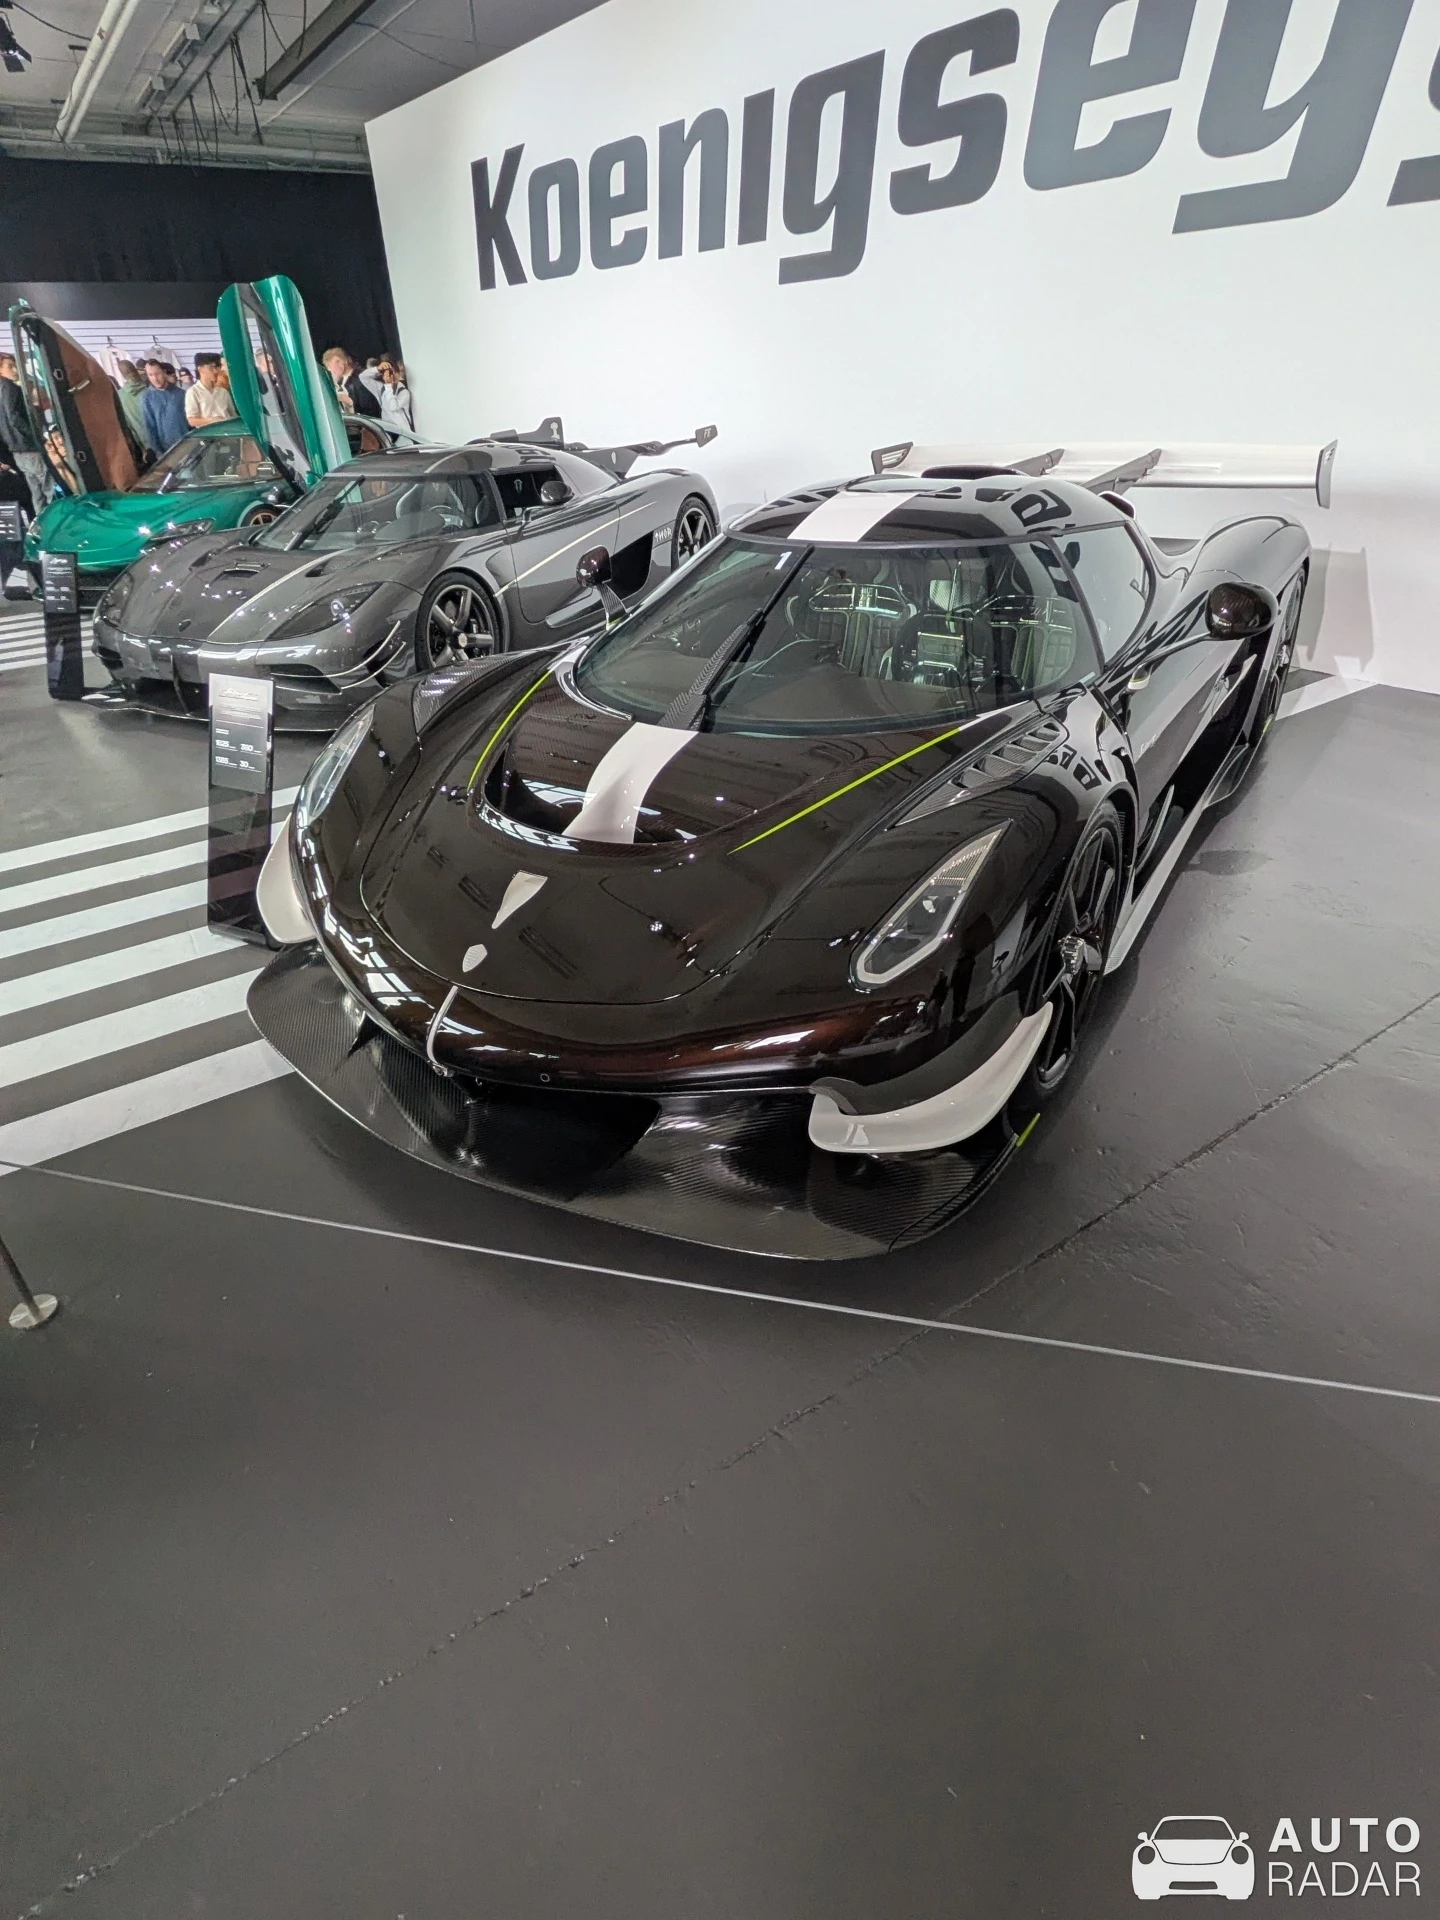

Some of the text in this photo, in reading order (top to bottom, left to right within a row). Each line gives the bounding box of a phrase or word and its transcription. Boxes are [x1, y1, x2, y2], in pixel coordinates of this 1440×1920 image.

[470, 0, 1440, 291] Koenigseg
[654, 527, 672, 543] THOR
[774, 551, 792, 570] 1
